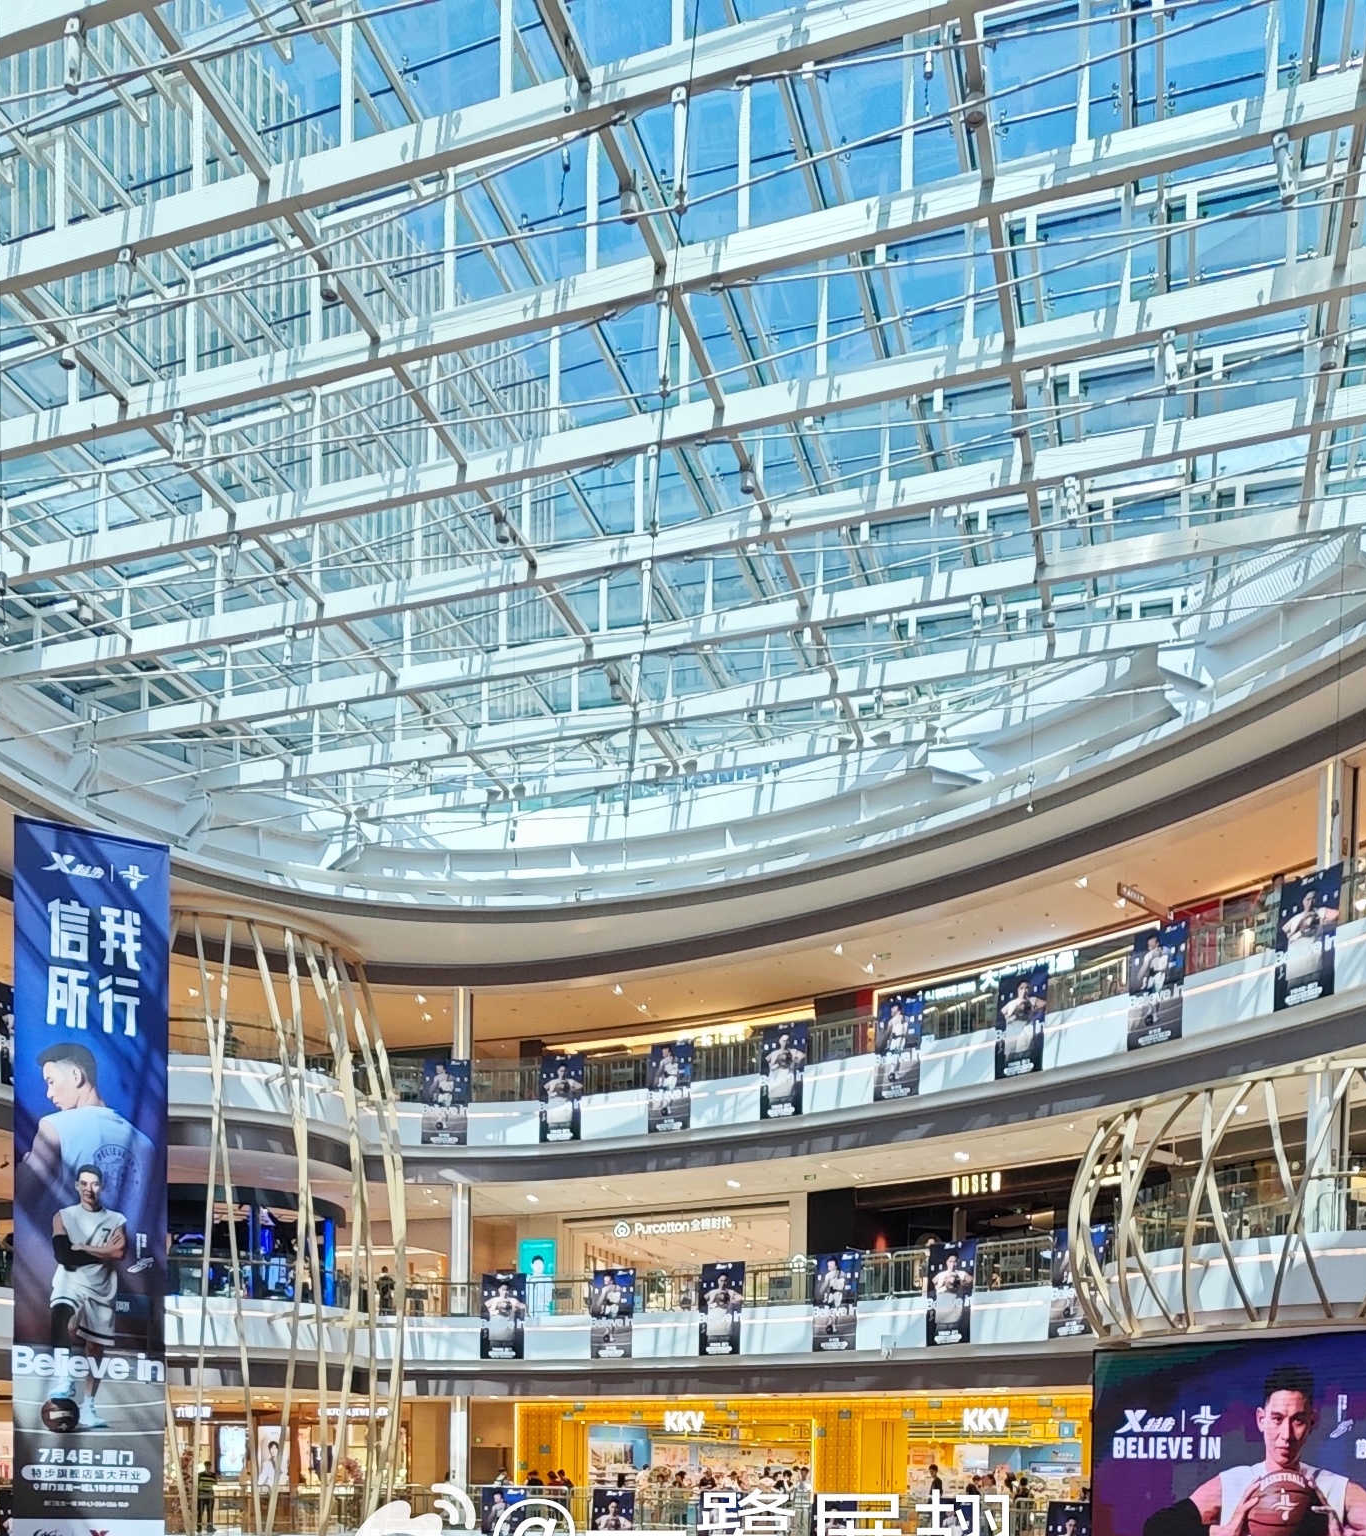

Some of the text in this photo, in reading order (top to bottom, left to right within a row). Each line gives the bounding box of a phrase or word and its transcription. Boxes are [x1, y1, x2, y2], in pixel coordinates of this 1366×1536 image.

[635, 1219, 690, 1236] Purcotton
[12, 1344, 165, 1382] Believe in
[664, 1411, 705, 1432] KKV
[963, 1407, 1010, 1433] KKV
[1113, 1436, 1221, 1460] BELIEVE IN
[31, 1467, 141, 1481] 特步旗舰店盛大开业
